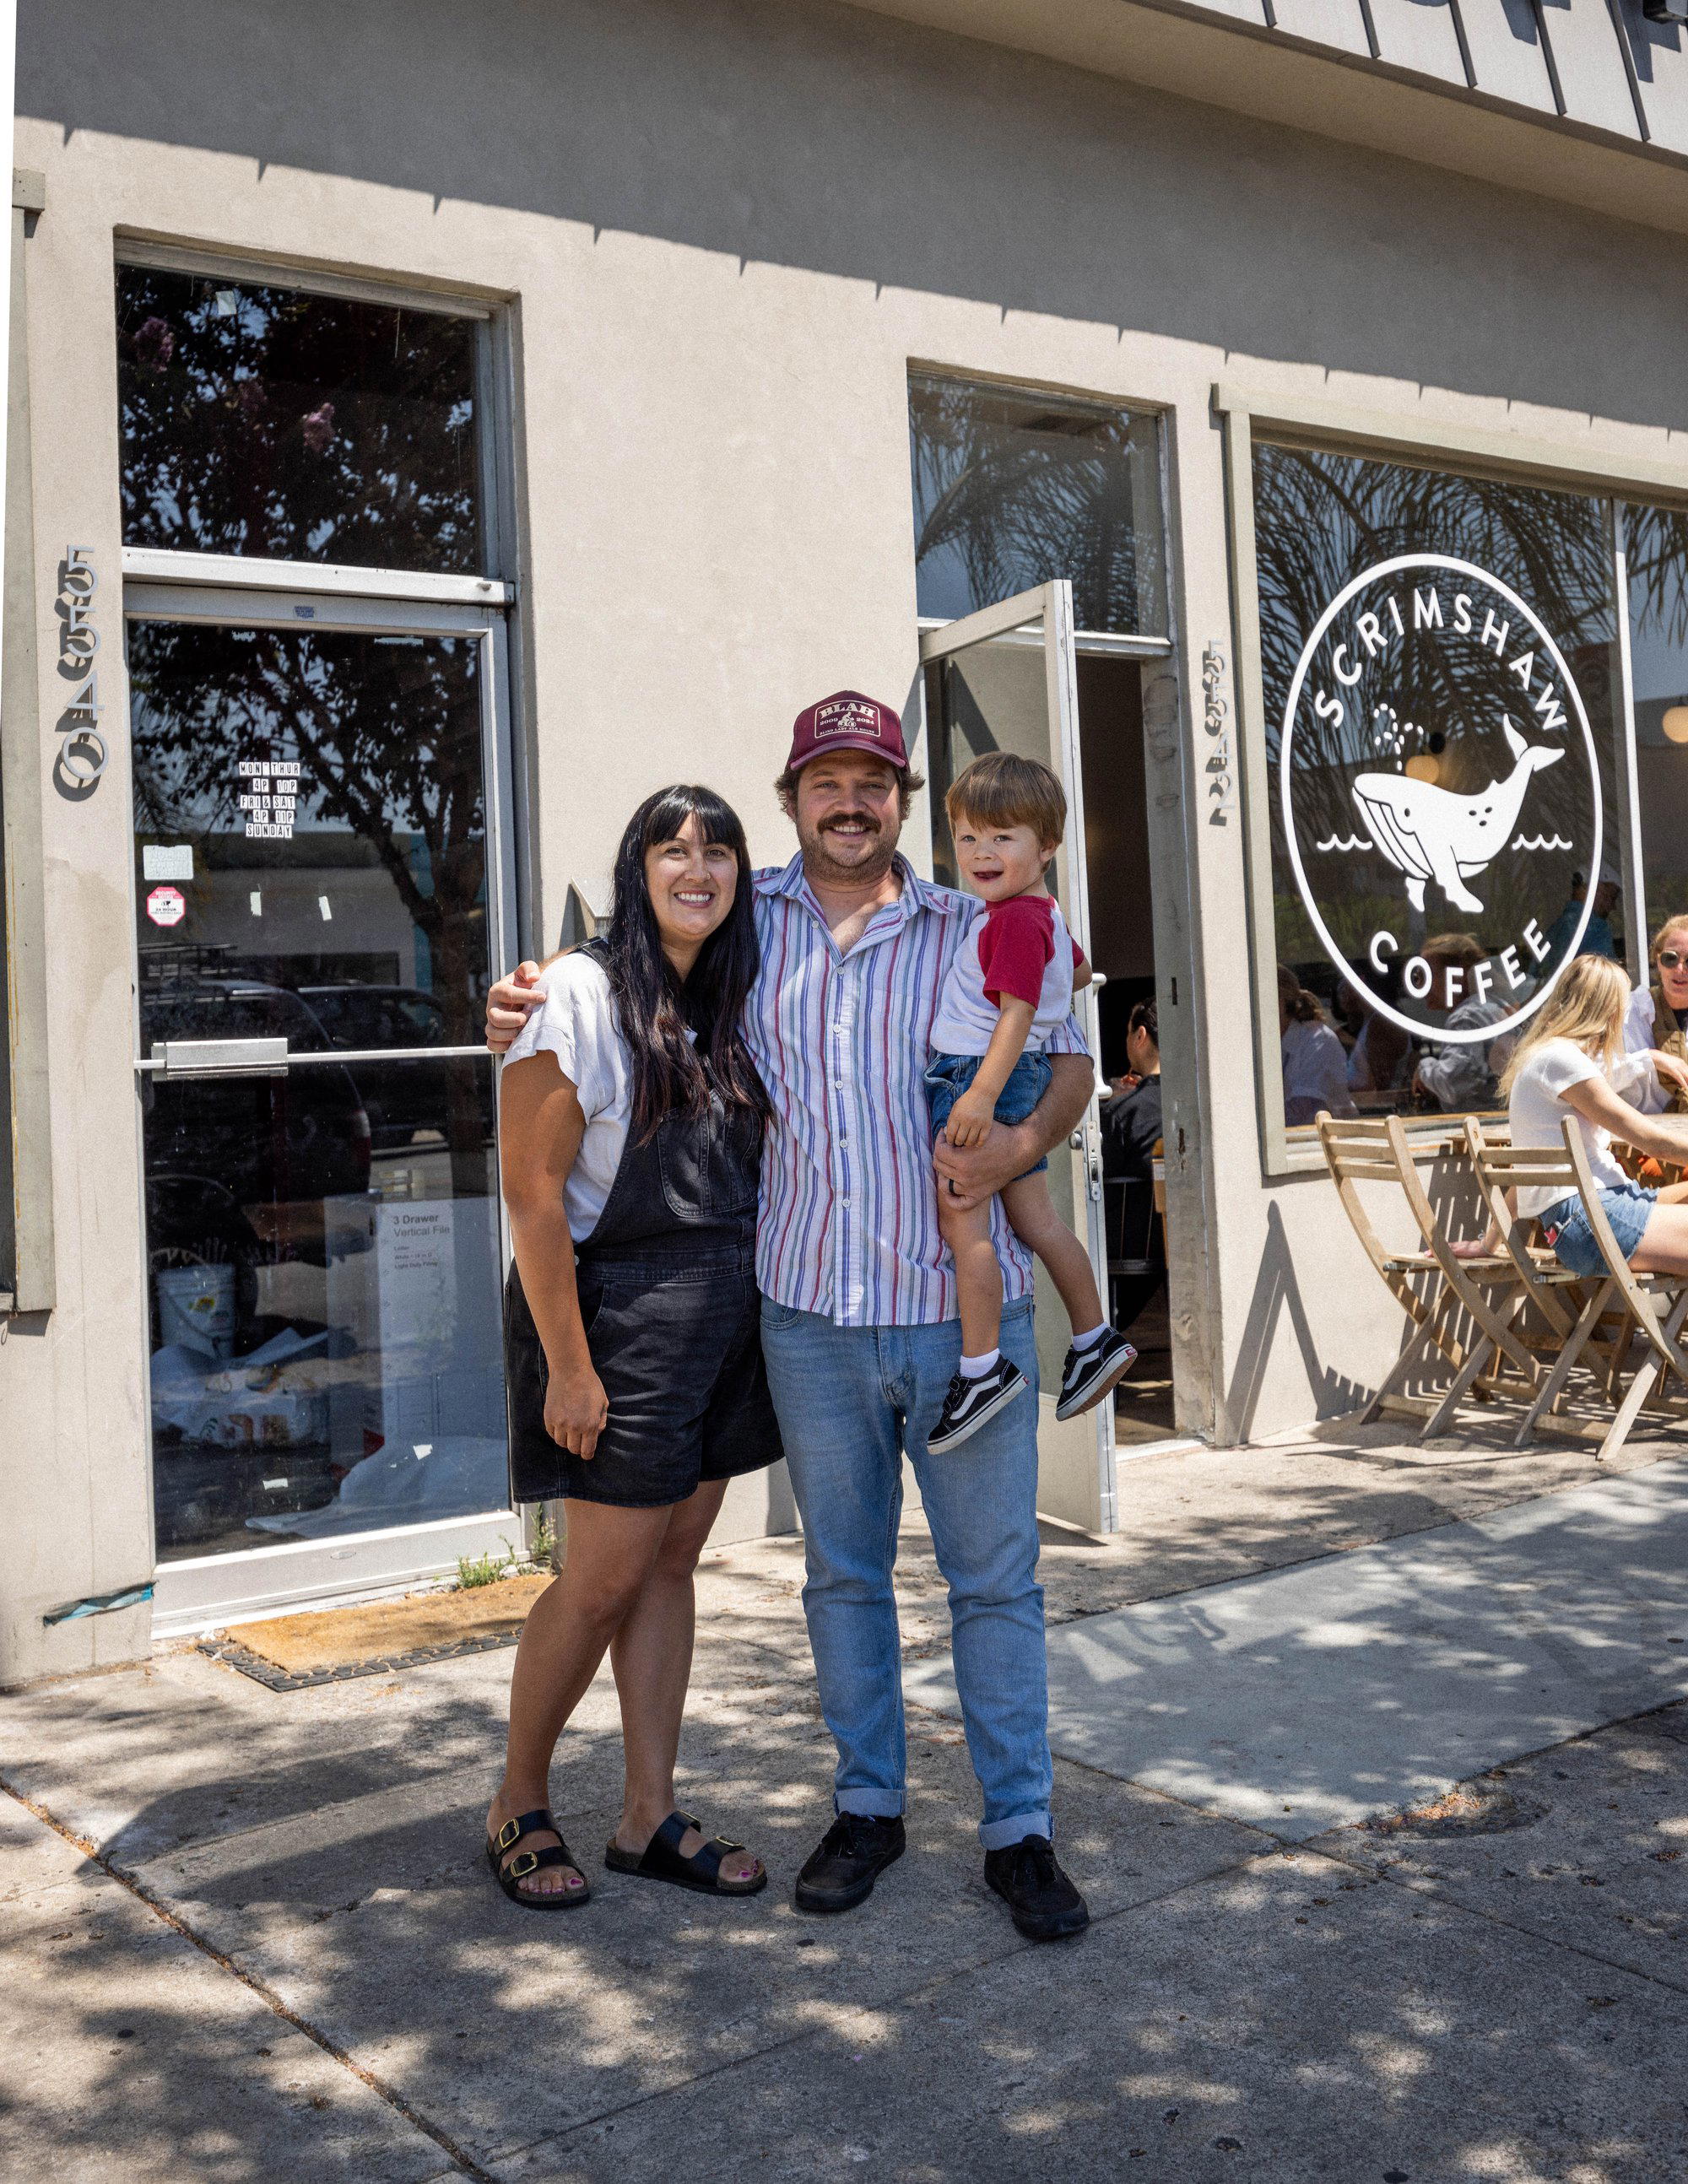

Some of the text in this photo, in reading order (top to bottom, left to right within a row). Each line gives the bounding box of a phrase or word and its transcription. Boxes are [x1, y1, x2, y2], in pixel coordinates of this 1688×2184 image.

[63, 544, 109, 780] 5540
[1315, 587, 1568, 732] SCRIMSHAW
[819, 703, 876, 719] BLAH
[1209, 639, 1235, 809] 5542
[240, 763, 261, 775] MON
[272, 763, 300, 775] THUR
[254, 779, 295, 792] 4P 10P
[241, 796, 260, 808] FRI
[273, 796, 294, 808] SAT
[254, 811, 293, 824] 4P 11P
[246, 824, 291, 836] SUNDAY
[1369, 918, 1551, 1007] COFFEE
[393, 1214, 439, 1224] 3 Drawer
[393, 1225, 450, 1237] Vertical File
